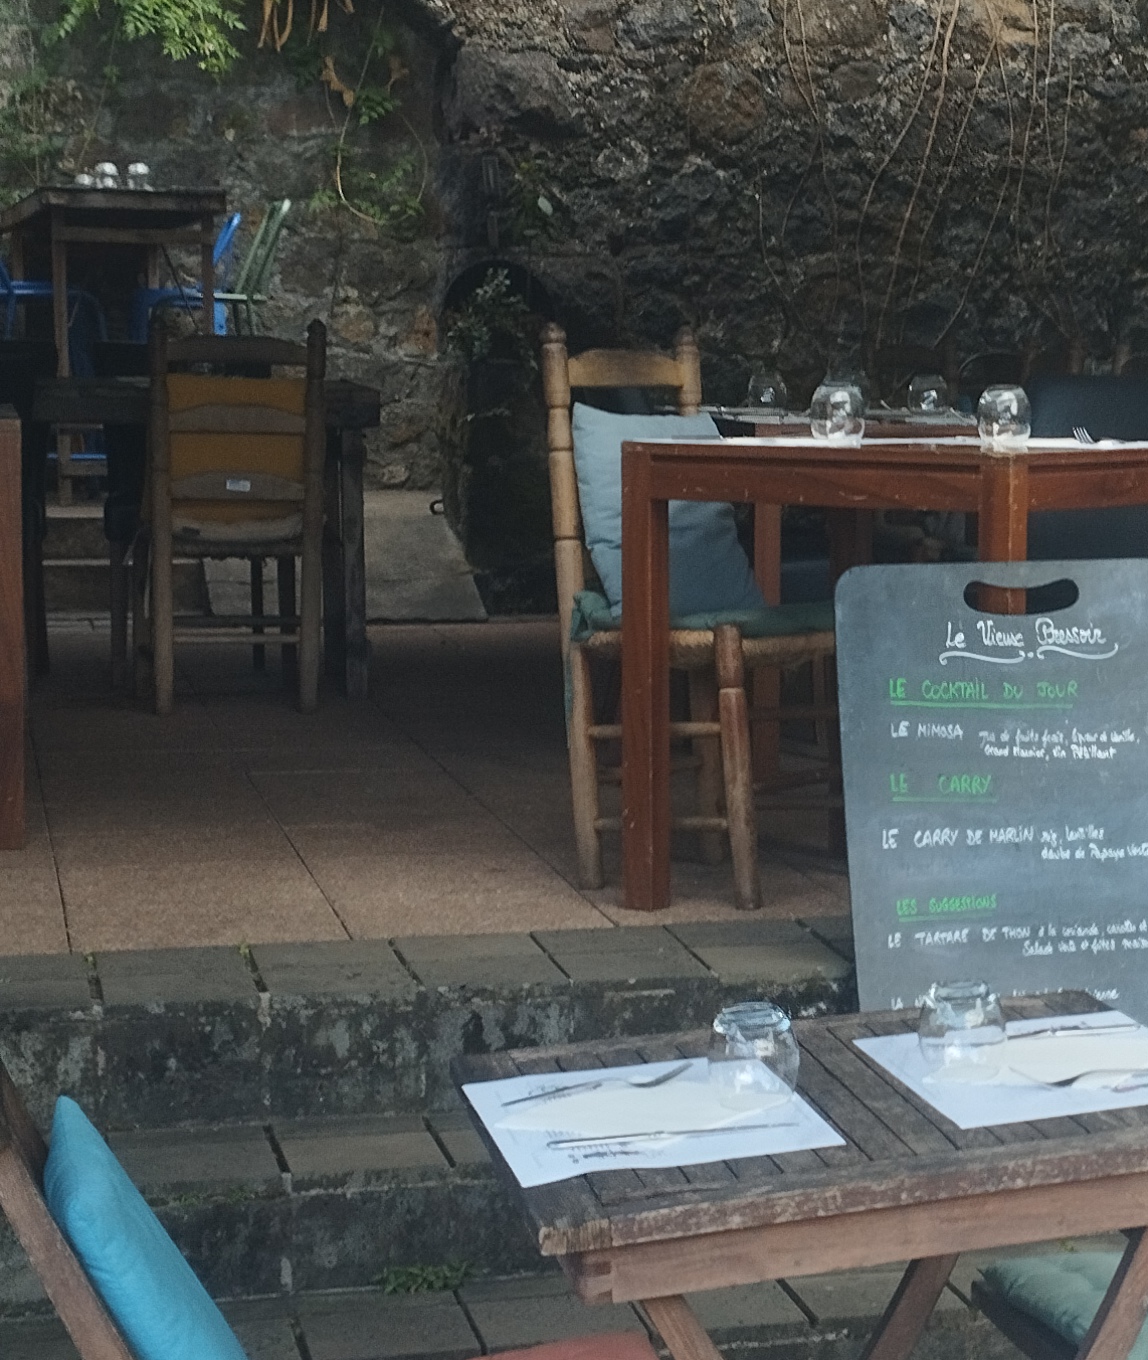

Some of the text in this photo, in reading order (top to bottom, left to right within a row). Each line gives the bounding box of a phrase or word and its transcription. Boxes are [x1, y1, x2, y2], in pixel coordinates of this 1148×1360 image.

[945, 621, 967, 649] Le
[889, 677, 1079, 700] LE COCKTAIL DU JOUR
[890, 720, 910, 738] LE
[889, 772, 992, 795] LE CARRY
[882, 824, 1034, 849] LE CARRY DE MARLIN
[896, 897, 917, 916] LES
[888, 931, 902, 949] LE
[914, 926, 969, 946] TARTARE
